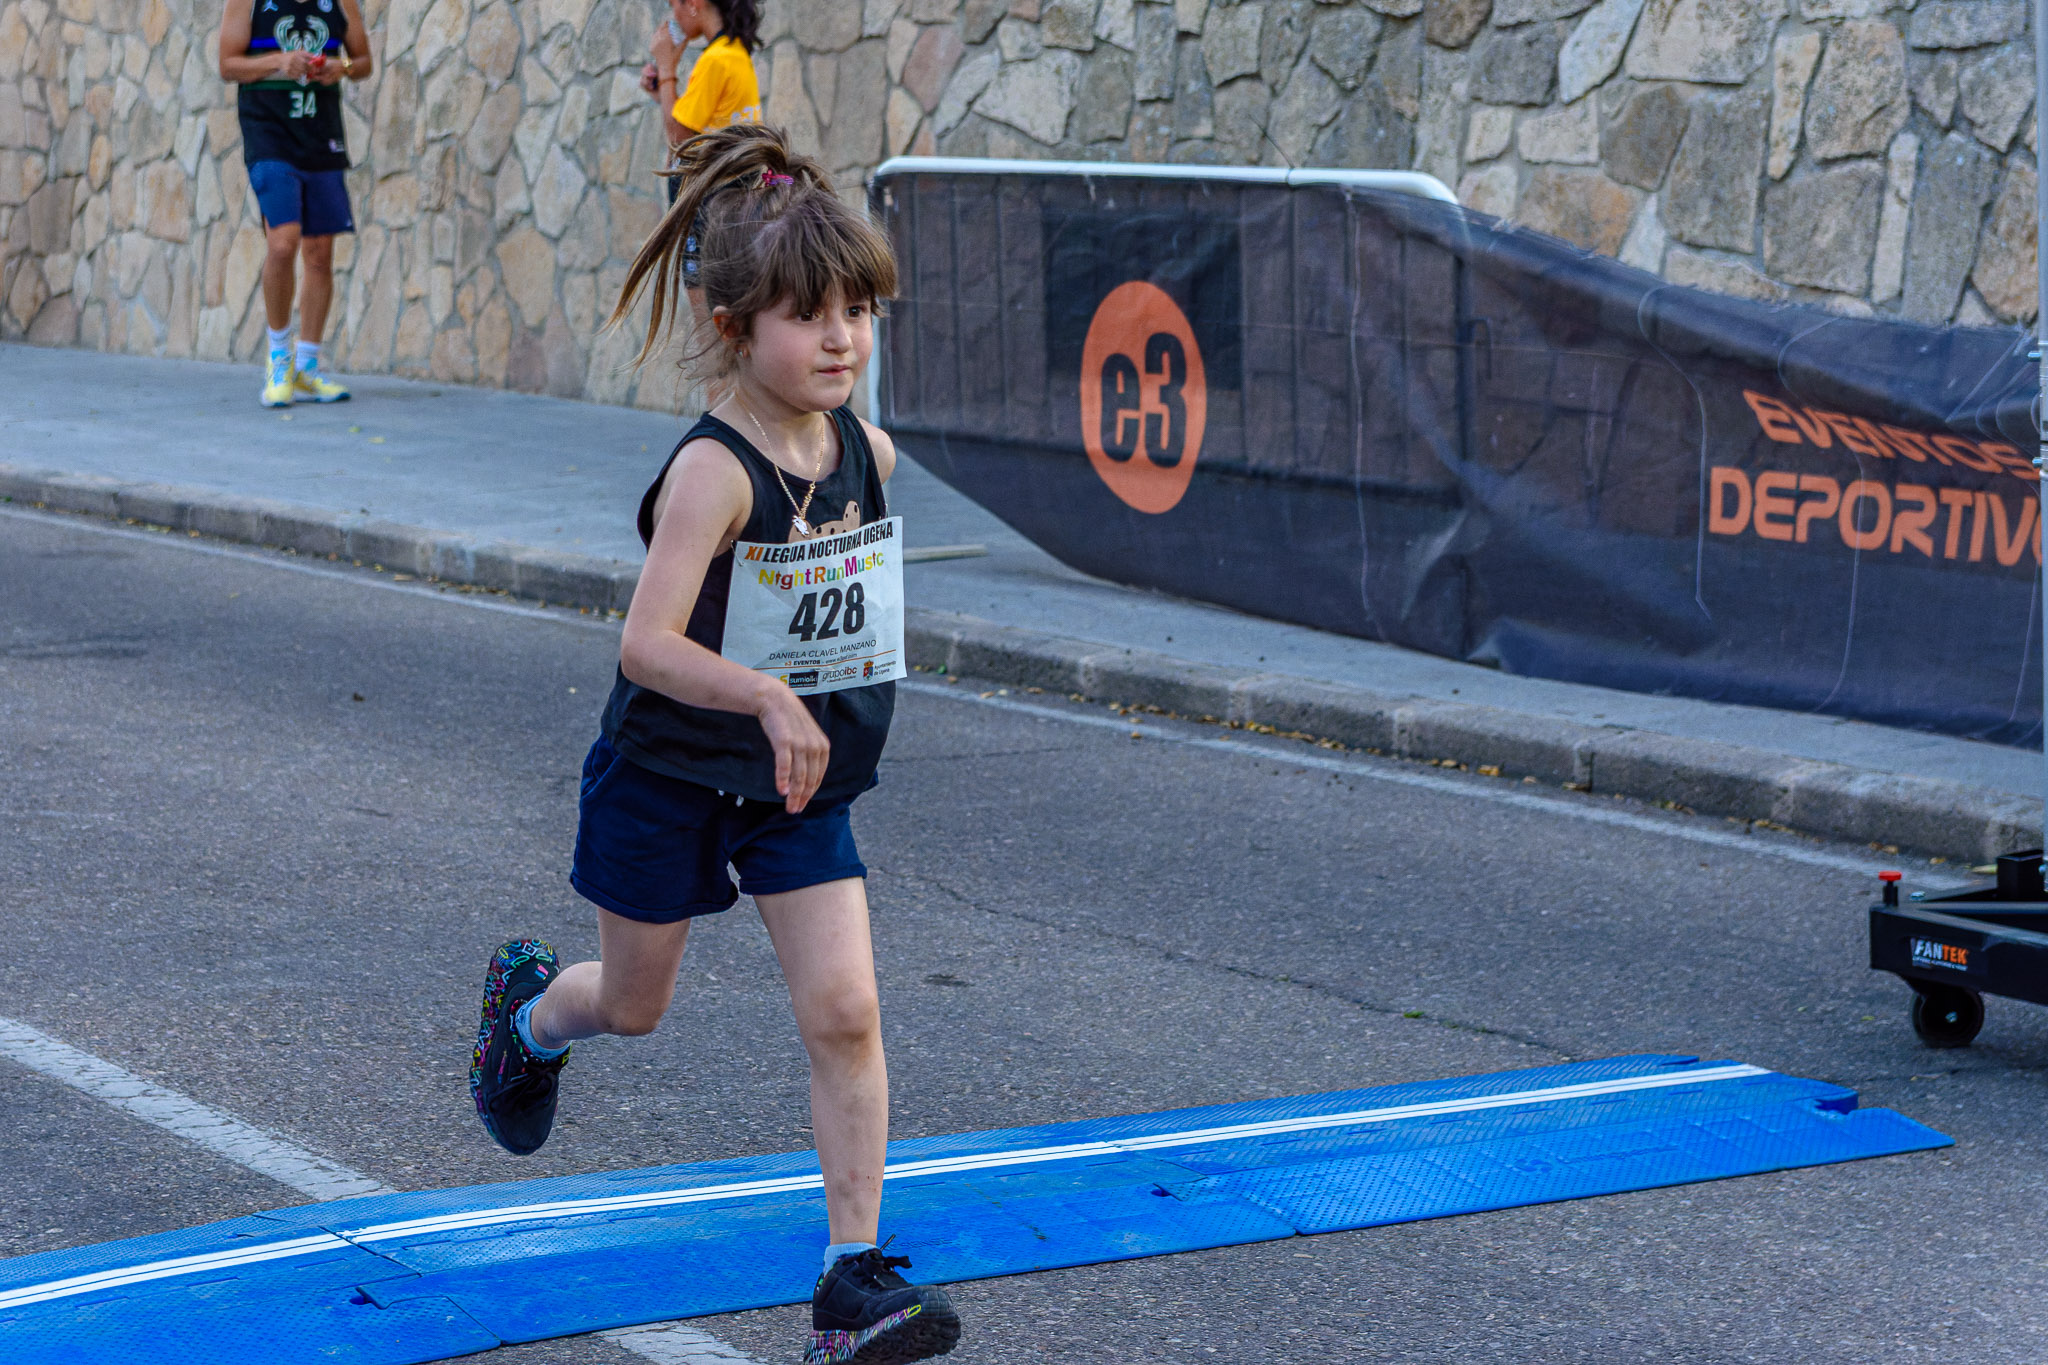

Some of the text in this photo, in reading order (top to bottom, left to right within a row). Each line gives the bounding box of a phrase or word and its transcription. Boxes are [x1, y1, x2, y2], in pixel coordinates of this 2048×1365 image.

[289, 90, 317, 119] 34
[1099, 331, 1187, 469] e3
[1743, 389, 2040, 481] EVENTOS
[1708, 466, 2042, 567] DEPORTIV
[744, 545, 764, 562] XI
[763, 545, 805, 564] LEGUA
[807, 531, 862, 560] NOCTURNA
[788, 582, 865, 642] 428
[769, 640, 877, 660] DANIELA CLAVEL MANZANO
[1914, 939, 1968, 966] FANTEK
